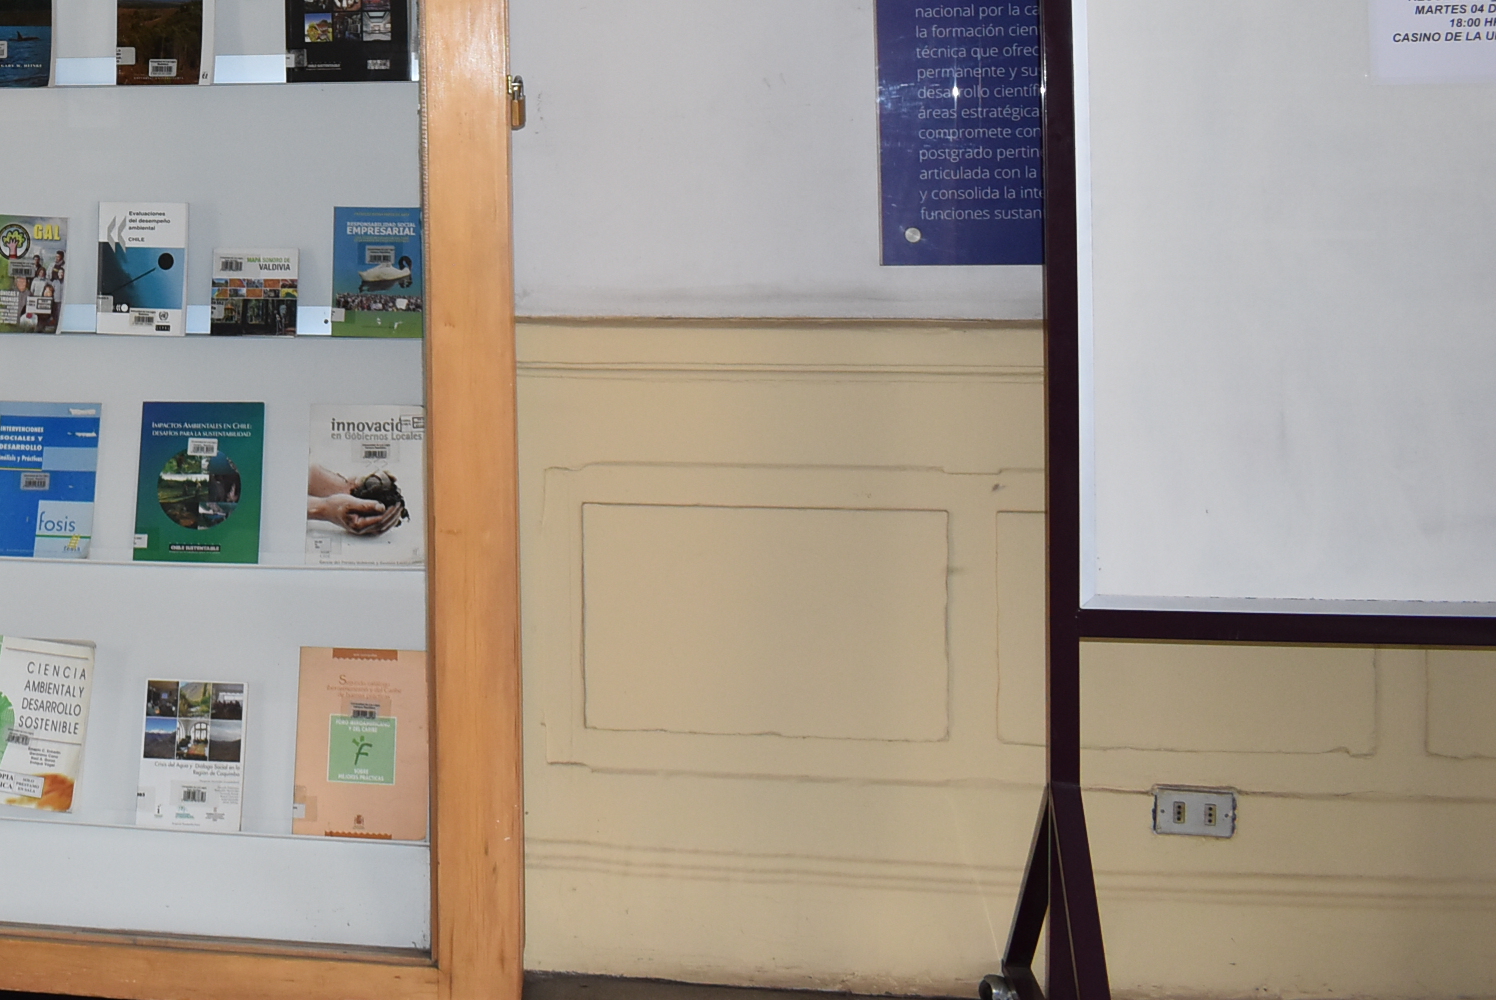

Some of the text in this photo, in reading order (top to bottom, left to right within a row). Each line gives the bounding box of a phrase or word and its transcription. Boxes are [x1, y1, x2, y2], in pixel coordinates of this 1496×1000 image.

[1415, 3, 1485, 15] MARTES 04
[1449, 17, 1481, 28] 18:00
[1392, 31, 1482, 43] CASINO DE LA
[33, 223, 60, 241] GAL
[346, 226, 416, 236] EMPRESARIAL
[258, 263, 291, 272] VALDIVIA
[331, 432, 422, 441] en Gobiernos Locales
[38, 511, 76, 533] fosis
[27, 661, 86, 681] CIENCIA
[23, 680, 85, 699] AMBIENTAL Y
[21, 697, 82, 717] DESARROLLO
[18, 715, 79, 735] SOSTENIBLE
